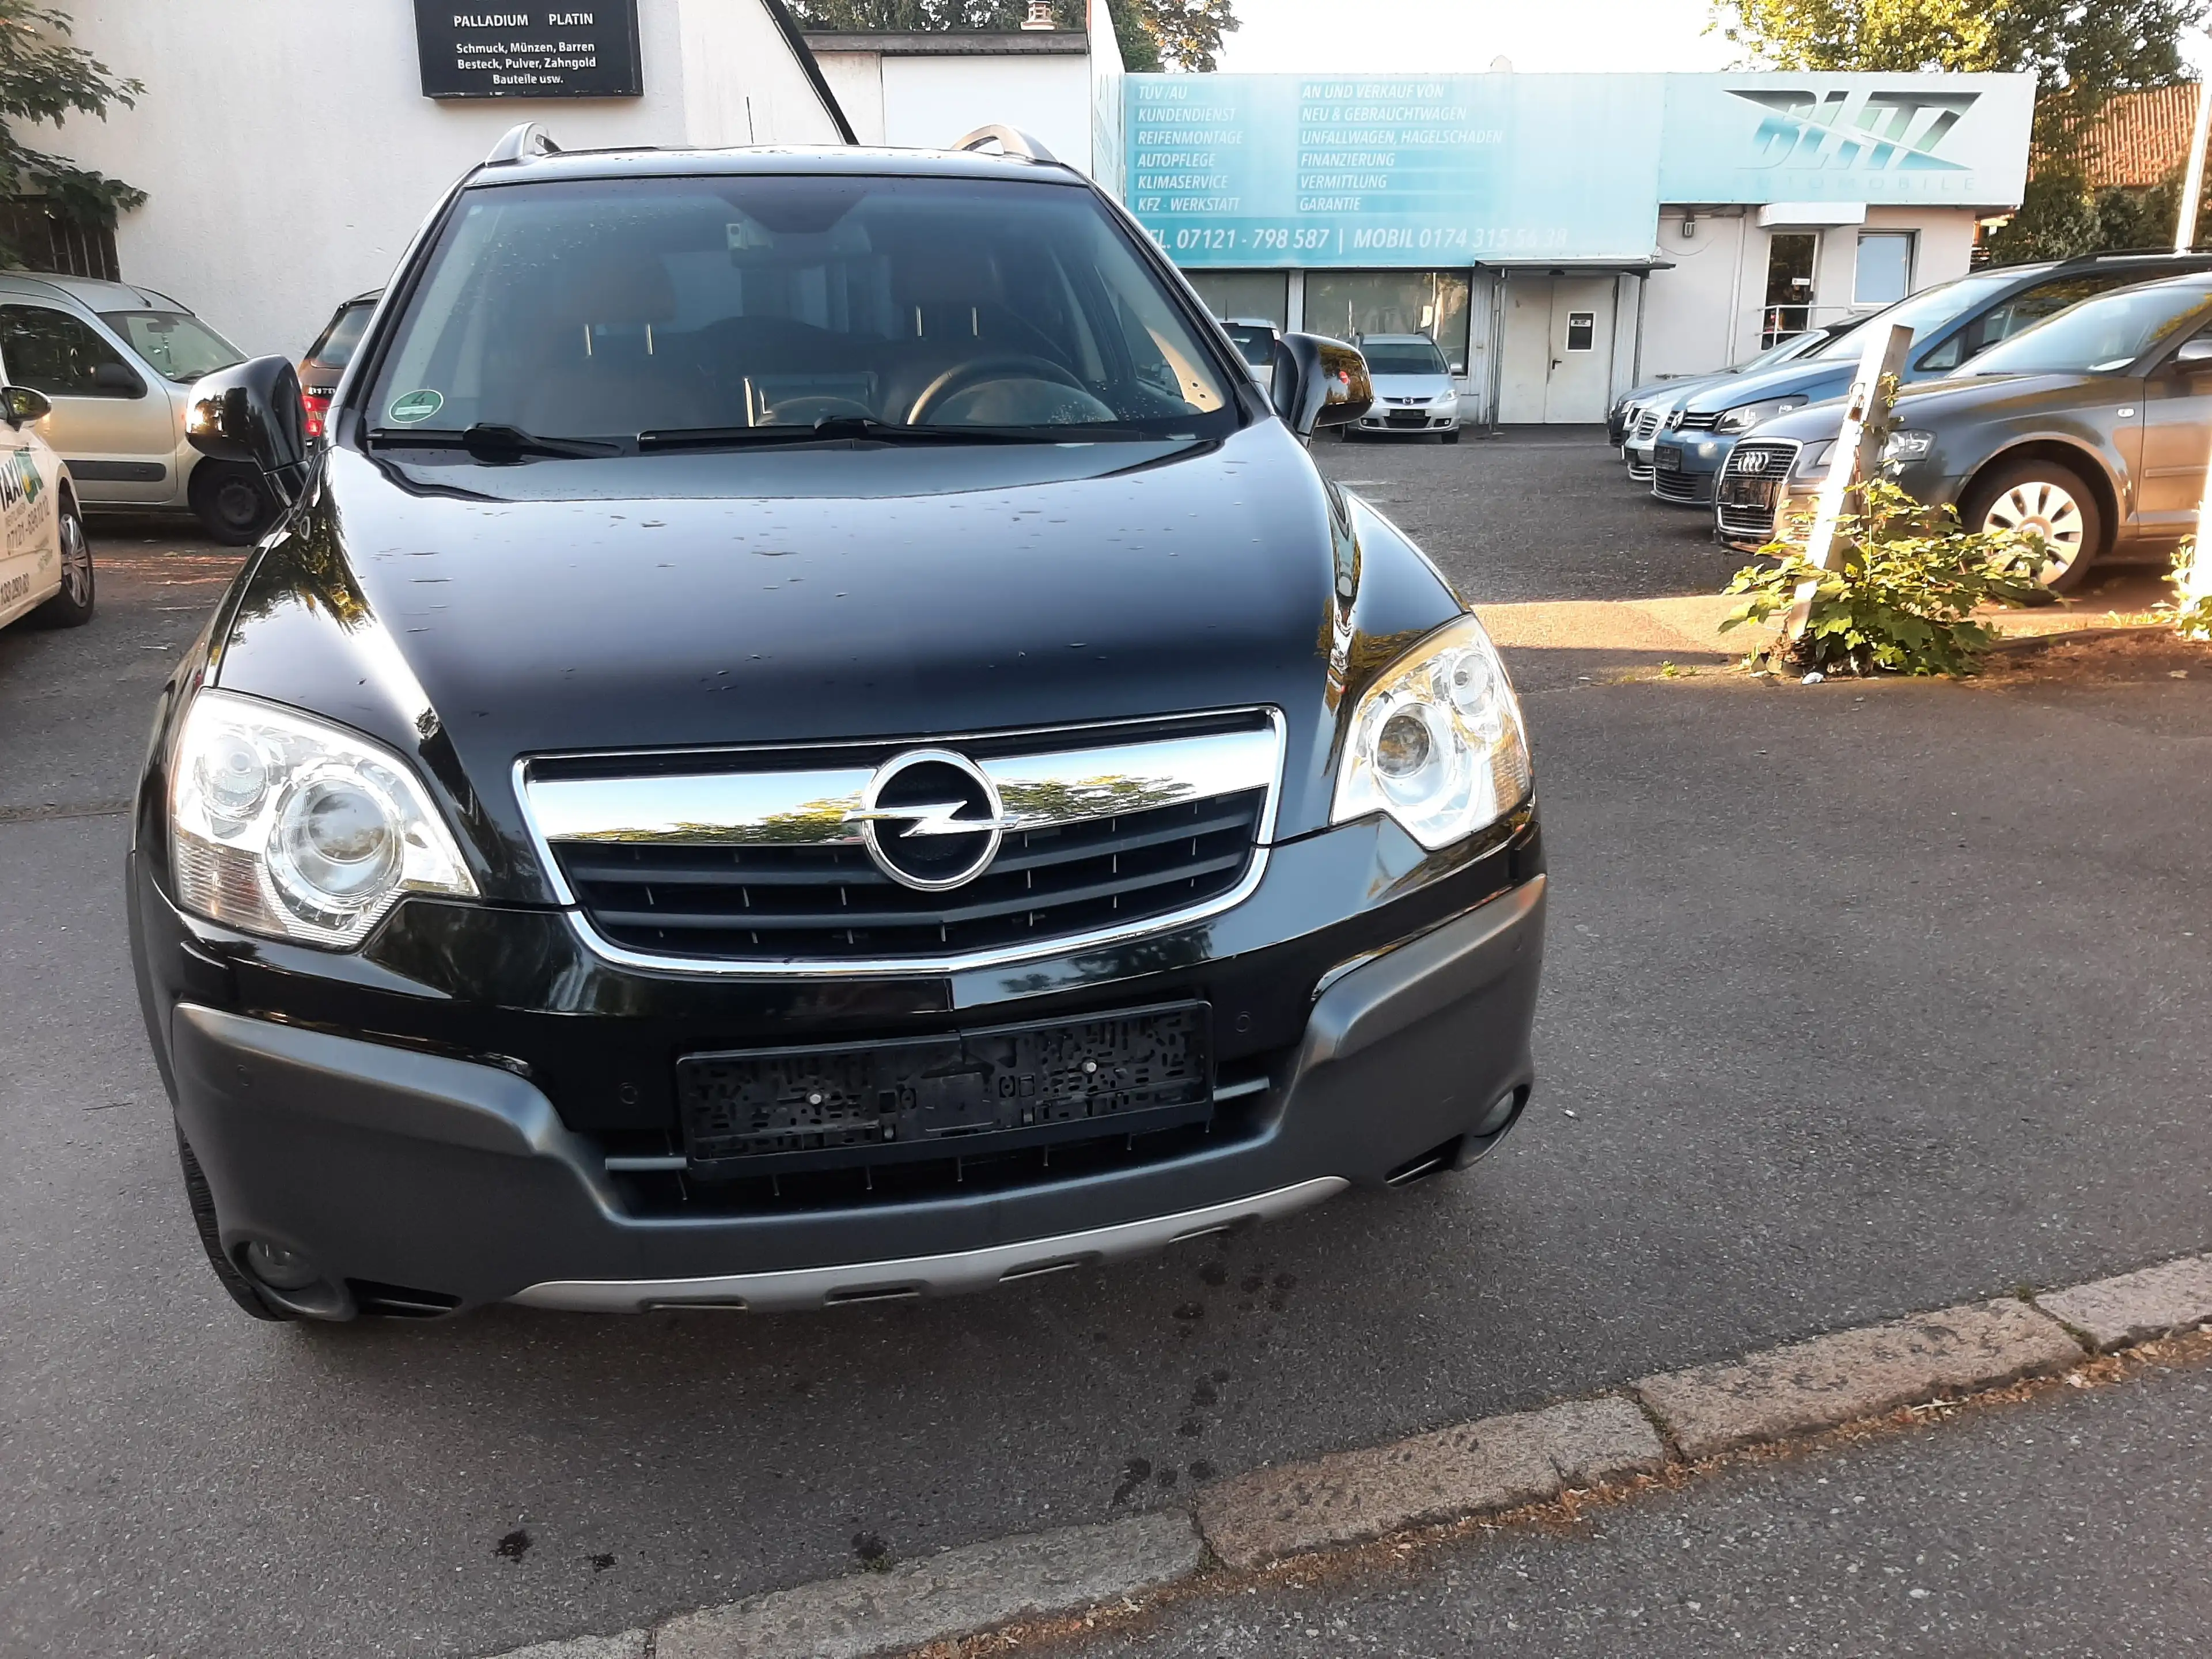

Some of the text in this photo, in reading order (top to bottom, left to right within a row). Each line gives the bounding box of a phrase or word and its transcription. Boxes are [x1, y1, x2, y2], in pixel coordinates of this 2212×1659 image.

[454, 13, 593, 27] PALLADIUM PLATIN
[456, 42, 594, 54] Schmuck, Münzen, Barren
[458, 57, 596, 70] Besteck, Pulver, Zahngold
[493, 74, 563, 84] Bauteile usw.
[1302, 84, 1444, 99] AN UND VERKAUF VON
[1138, 107, 1236, 122] KUNDENDIENST
[1302, 107, 1467, 122] NEU & GEBRAUCHTWAGEN
[1138, 130, 1244, 145] REIFENMONTAGE
[1301, 130, 1397, 146] UNFALLWAGEN,
[1137, 153, 1215, 167] AUTOPFLEGE
[1300, 153, 1395, 167] FINANZIERUNG
[1138, 175, 1228, 190] KLIMASERVICE
[1300, 175, 1387, 189] VERMITTLUNG
[1732, 177, 1975, 191] AUTOMOBILE
[1138, 198, 1161, 211] KFZ
[1171, 198, 1240, 211] WERKSTATT
[1300, 197, 1361, 211] GARANTIE
[1177, 229, 1236, 249] 07121
[1252, 229, 1288, 249] 798
[1293, 229, 1330, 249] 587
[1354, 228, 1414, 248] MOBIL
[1419, 228, 1467, 248] 0174
[1472, 228, 1510, 248] 315
